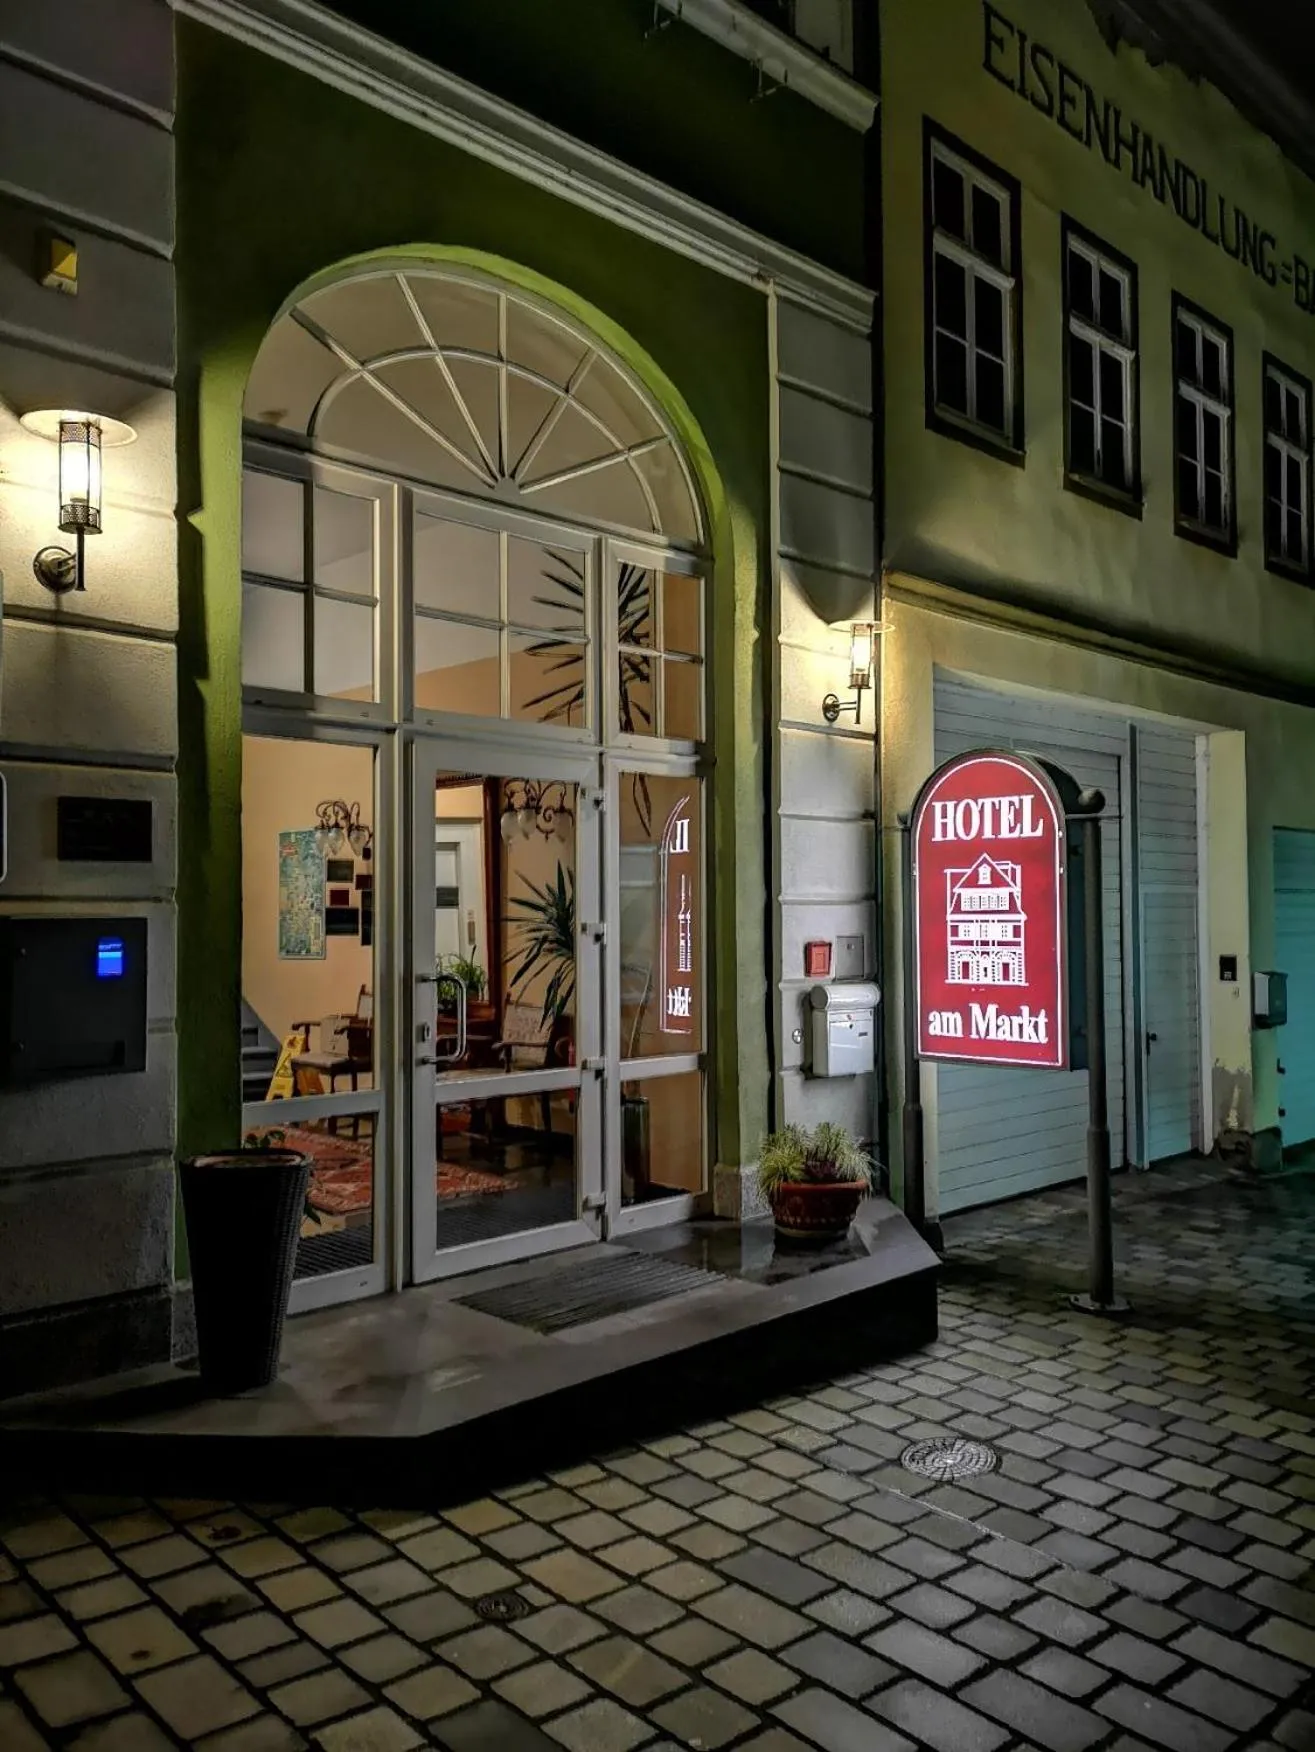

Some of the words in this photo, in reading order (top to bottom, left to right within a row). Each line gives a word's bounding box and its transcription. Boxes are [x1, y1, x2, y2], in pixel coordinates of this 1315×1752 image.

[932, 795, 1043, 842] HOTEL
[928, 1009, 963, 1038] am
[969, 1003, 1048, 1044] Markt
